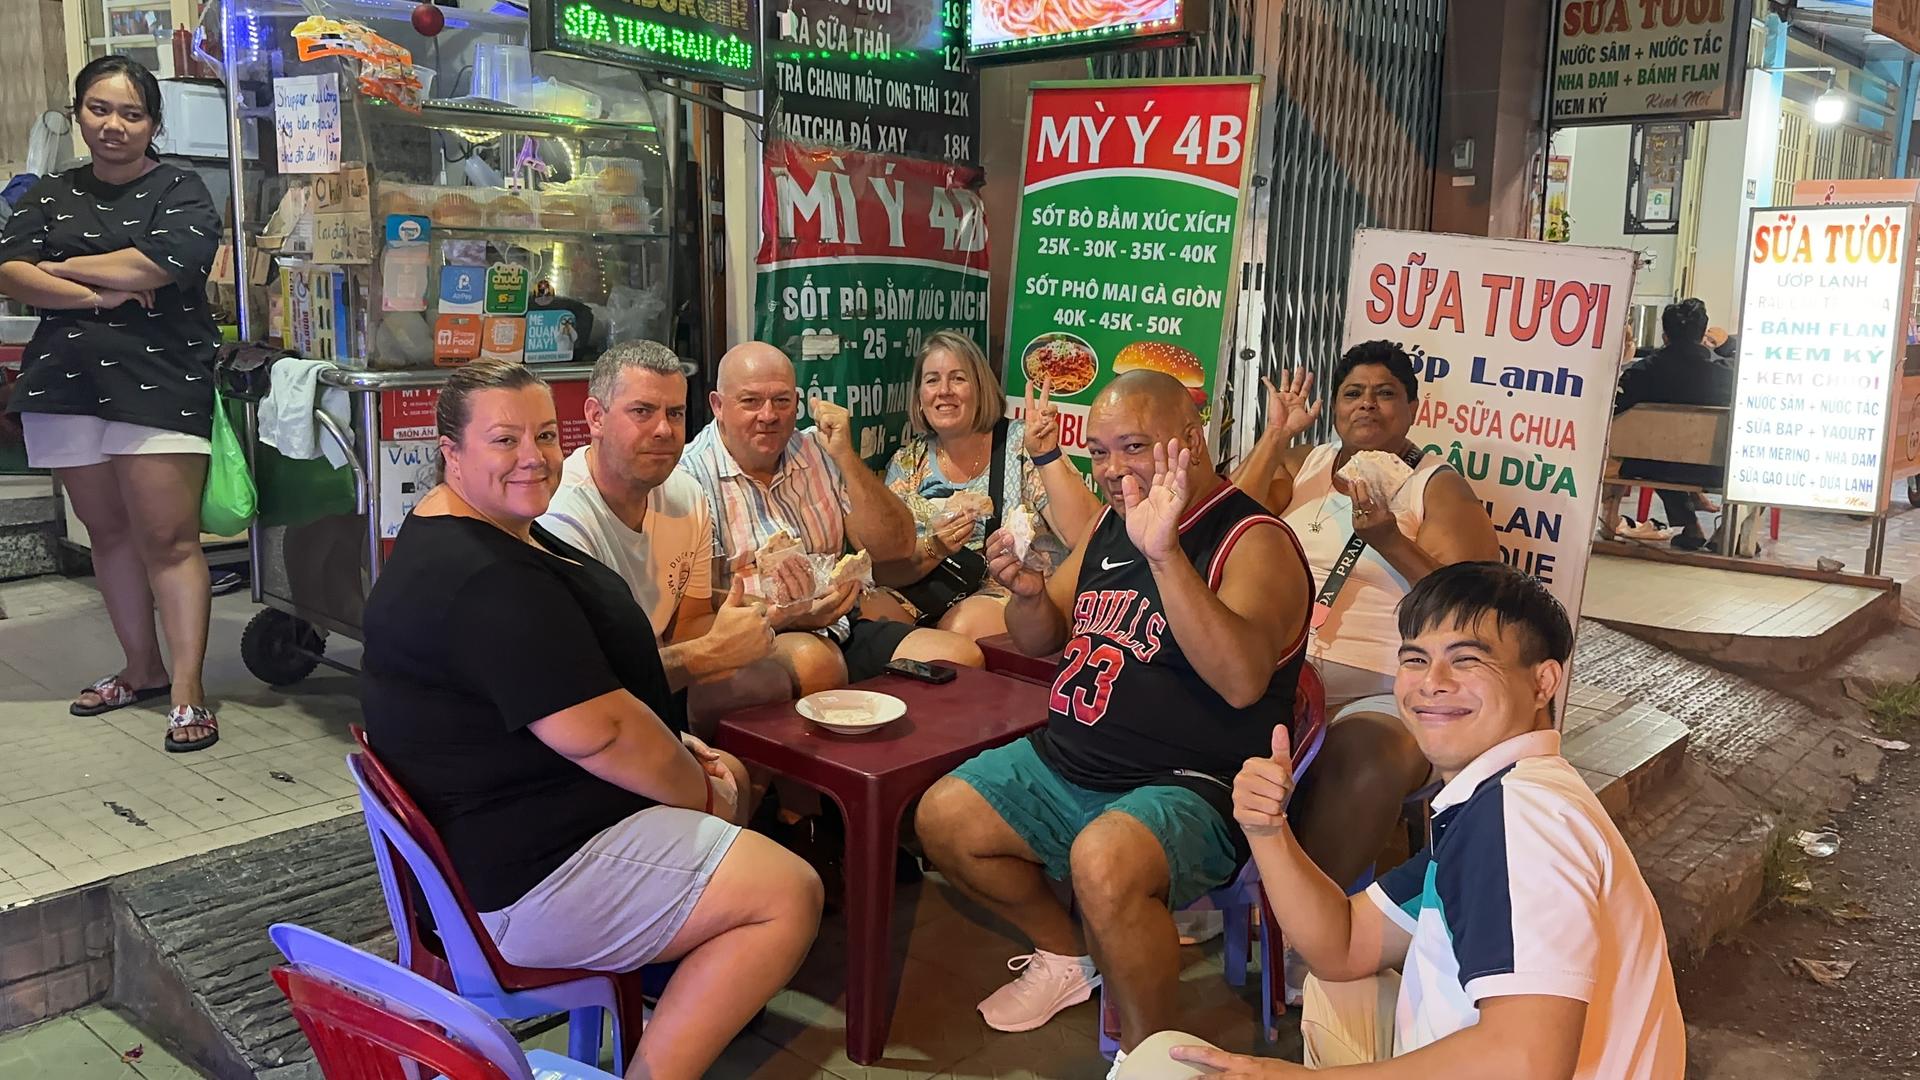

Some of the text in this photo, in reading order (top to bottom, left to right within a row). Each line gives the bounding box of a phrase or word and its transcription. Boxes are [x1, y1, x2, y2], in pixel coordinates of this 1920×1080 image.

[715, 34, 753, 70] CÂU
[816, 15, 848, 52] SỮA
[854, 24, 891, 60] THÁI
[1560, 43, 1596, 66] NƯỚC
[1600, 41, 1631, 63] SÂM
[1649, 35, 1689, 59] NƯỚC
[776, 59, 969, 117] TRÀ CHANH MẬT ONG THÁI 12K
[1557, 72, 1584, 91] NHA
[1637, 64, 1677, 86] BÁNH
[1682, 63, 1720, 82] FLAN
[1555, 97, 1584, 116] KEM
[1589, 92, 1608, 114] KÝ
[850, 116, 872, 150] ĐÁ
[877, 125, 908, 153] XAY
[944, 134, 970, 160] 18K
[1036, 101, 1243, 165] MỲ Ý 4B
[869, 163, 906, 247] Ý
[1653, 193, 1663, 205] 6
[1032, 203, 1231, 234] SỐT BÒ BẰM XÚC XÍCH
[1038, 238, 1071, 256] 25K
[1083, 240, 1117, 258] 30K
[1130, 242, 1166, 261] 35K
[1180, 245, 1217, 264] 40K
[1753, 213, 1901, 265] SỮA TƯƠI
[782, 274, 831, 321] SỐT
[917, 283, 945, 320] XÚC
[1026, 273, 1222, 309] SỐT PHÔ MAI GÀ GIÒN
[1366, 252, 1612, 350] SỮA TƯƠI
[529, 314, 544, 326] ME
[1053, 308, 1087, 327] 40K
[1099, 312, 1133, 332] 45K
[1146, 316, 1183, 336] 50K
[1829, 323, 1887, 338] FLAN
[453, 334, 475, 346] Food
[863, 327, 887, 360] 25
[1765, 346, 1831, 362] KEM
[1470, 356, 1584, 398] Lạnh
[1757, 371, 1803, 385] KEM
[847, 379, 883, 418] PHÔ
[1509, 412, 1576, 450] CHUA
[1822, 424, 1876, 441] YAOURT
[1742, 445, 1765, 459] KEM
[1768, 446, 1810, 463] MERINO
[1825, 450, 1848, 465] NHA
[1499, 453, 1578, 498] DỪA
[1073, 589, 1167, 663] BULLS
[1049, 635, 1125, 727] 23
